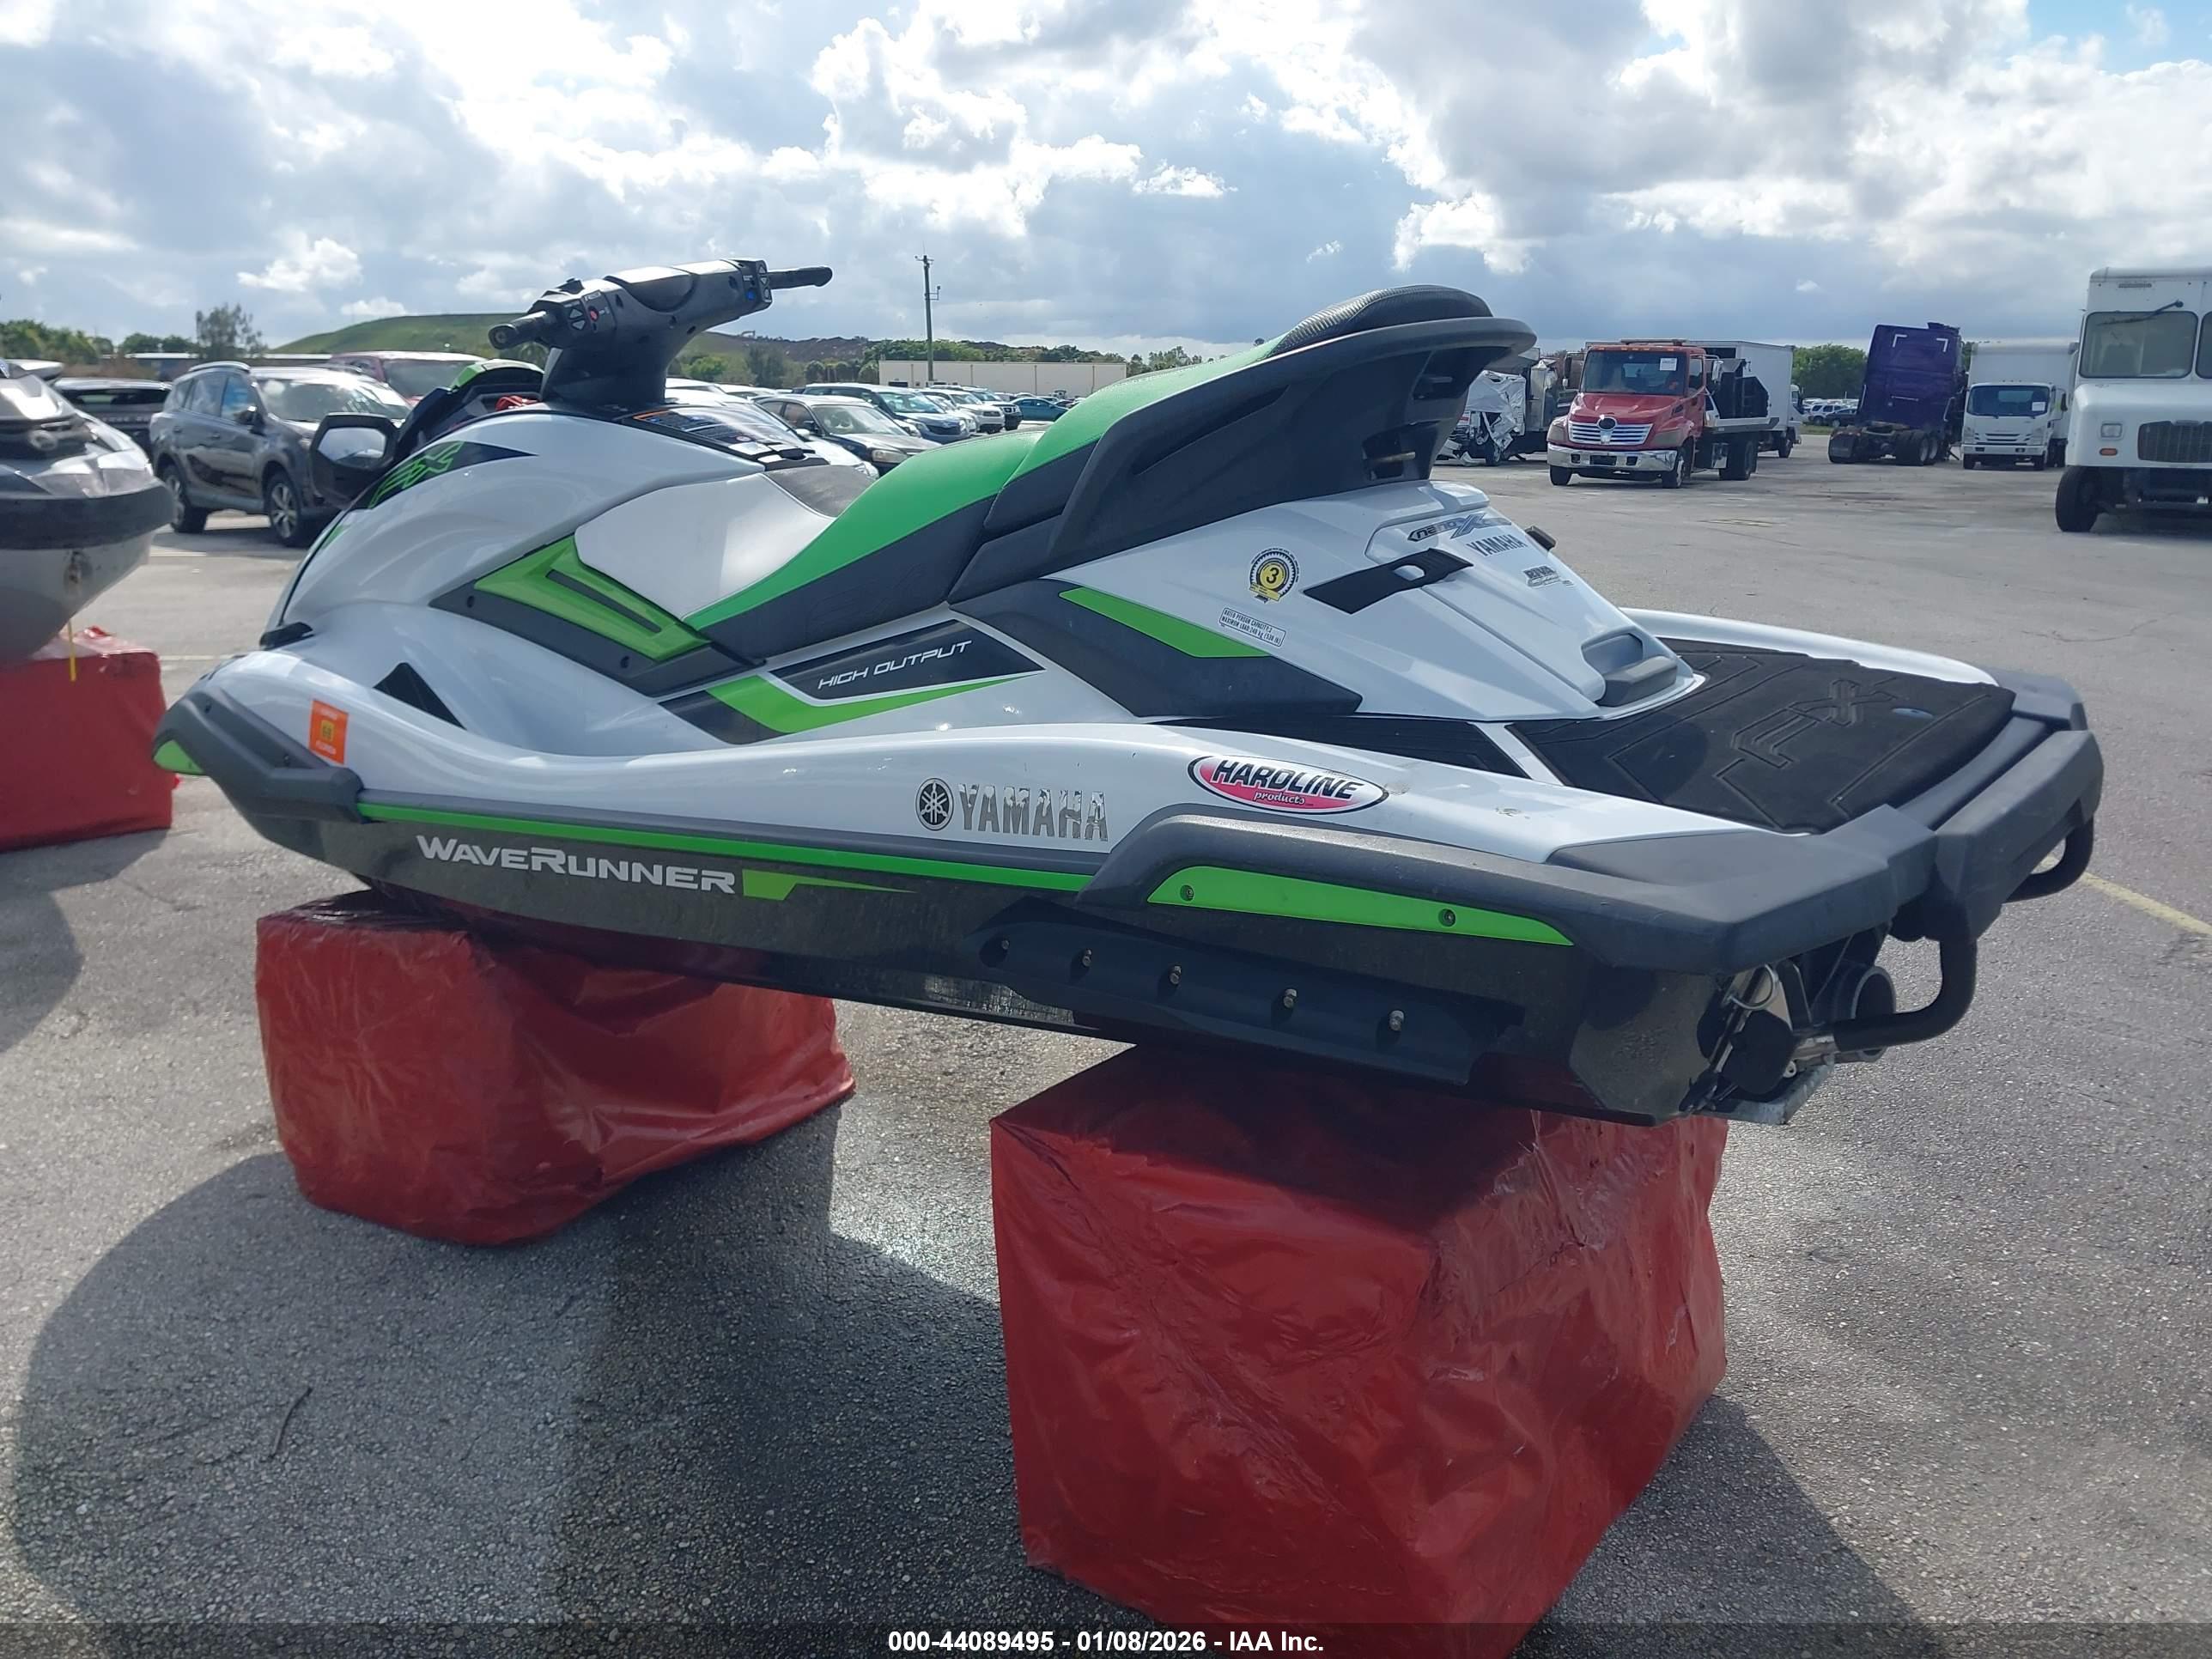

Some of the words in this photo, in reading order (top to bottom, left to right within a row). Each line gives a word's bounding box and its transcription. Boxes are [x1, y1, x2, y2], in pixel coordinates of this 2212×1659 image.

[1466, 534, 1528, 557] YAMAHA
[1266, 567, 1279, 584] 3
[1522, 565, 1557, 579] RIVA
[818, 666, 869, 690] HIGH
[873, 641, 972, 675] OUTPUT
[1211, 759, 1364, 800] HARDLINE
[1253, 791, 1306, 805] products
[957, 783, 1109, 842] YAMAHA
